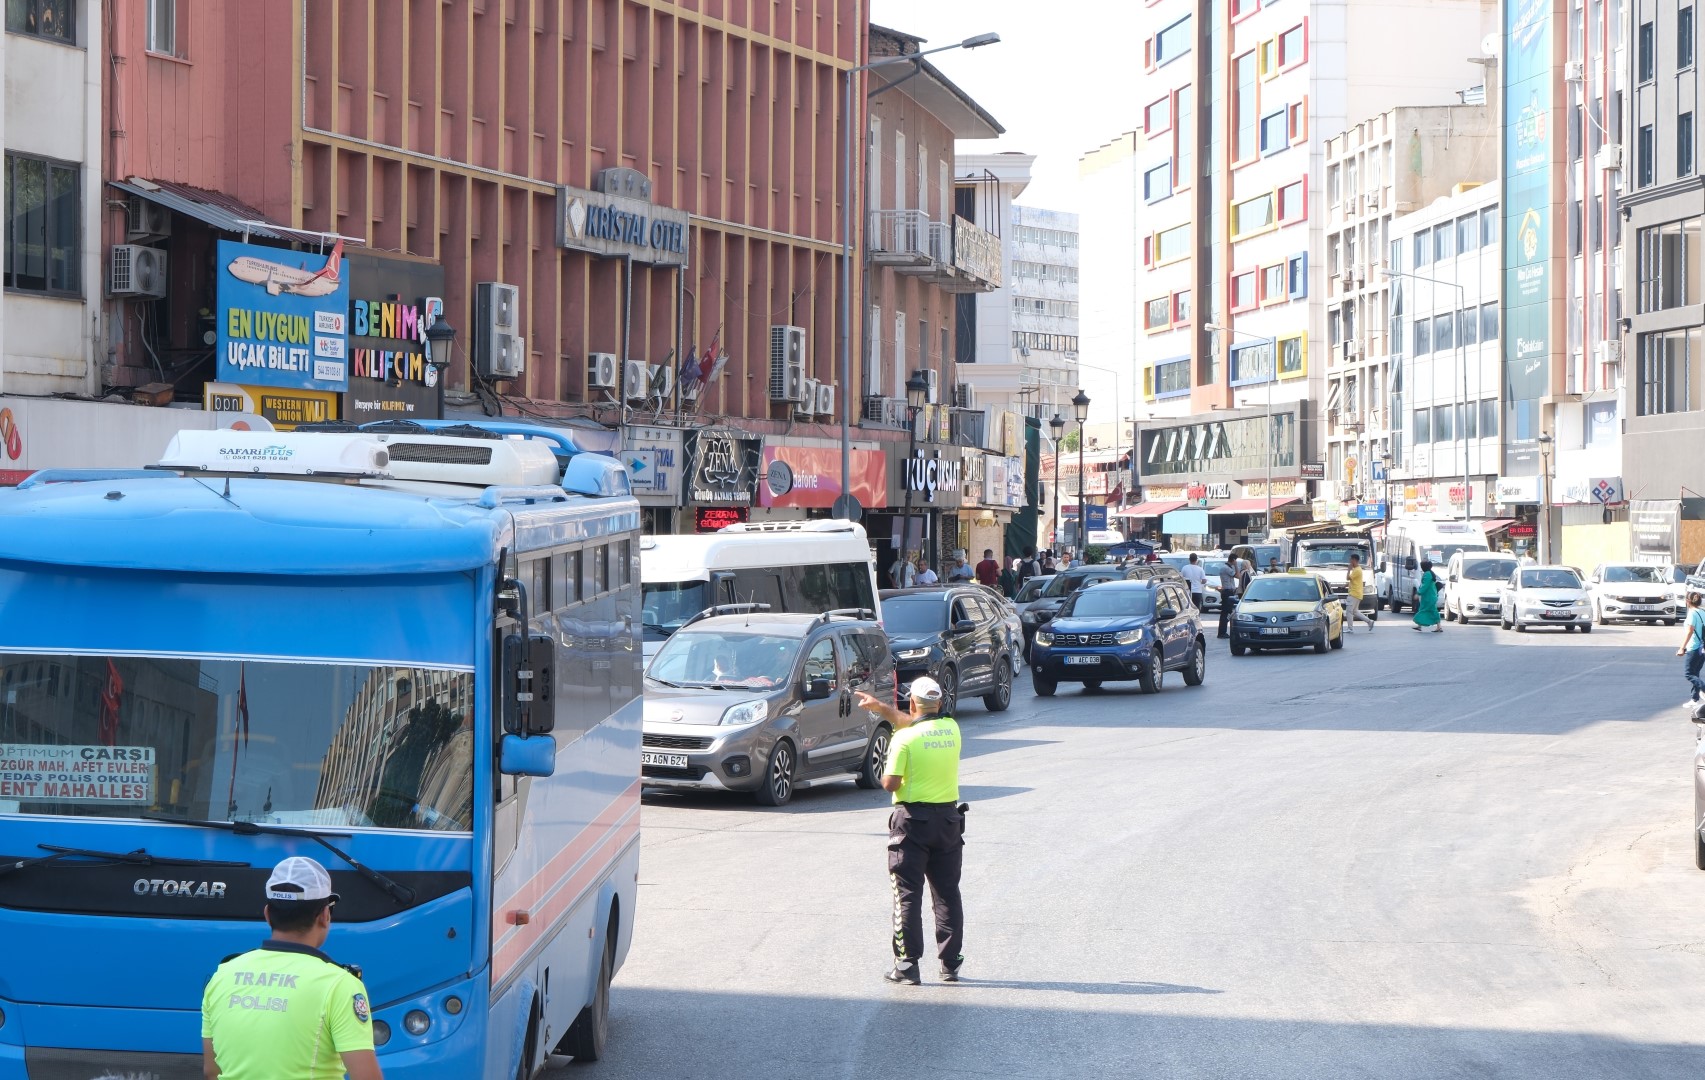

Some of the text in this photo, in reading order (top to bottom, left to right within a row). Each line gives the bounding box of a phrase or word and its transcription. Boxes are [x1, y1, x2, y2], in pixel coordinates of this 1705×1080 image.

[651, 219, 685, 254] OTEL
[355, 294, 417, 340] BENİM
[228, 307, 310, 344] EN UYGUN
[228, 342, 266, 370] UÇAK
[355, 348, 422, 388] KILIFÇIM
[215, 395, 239, 411] bpn
[265, 398, 301, 411] WESTERN
[277, 410, 302, 421] UNION
[709, 453, 735, 472] ZENA
[770, 469, 786, 481] ZENA
[793, 469, 818, 488] dafone
[1207, 483, 1228, 498] OTEL
[80, 748, 149, 762] ÇARŞI
[653, 754, 668, 765] AGN
[670, 755, 686, 766] 624
[0, 759, 34, 771] ZGÜR
[38, 761, 69, 772] MAH.
[72, 762, 104, 773] AFET
[97, 775, 148, 783] OKULU
[0, 781, 38, 796] ENT
[133, 878, 227, 899] OTOKAR
